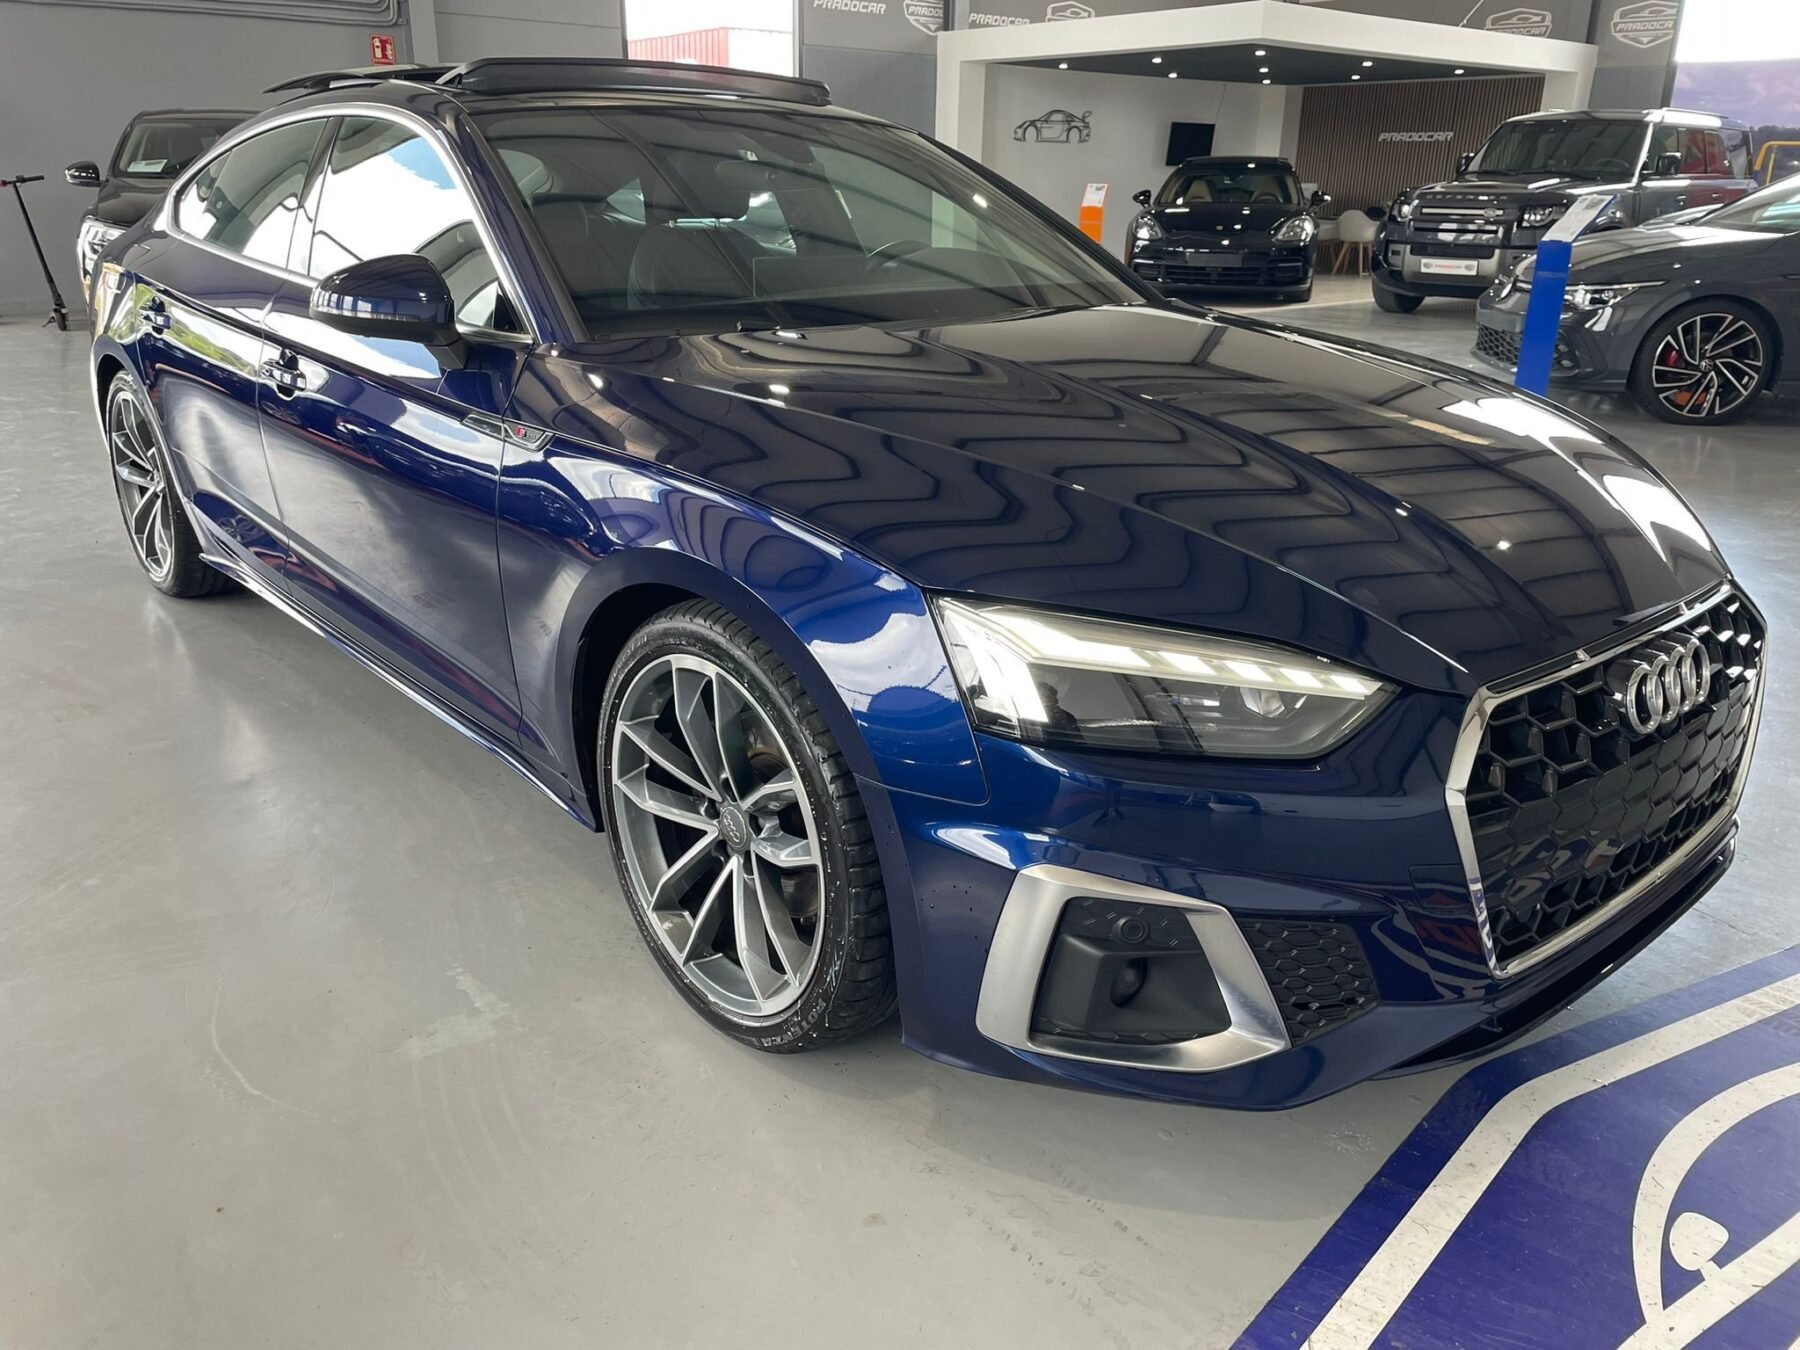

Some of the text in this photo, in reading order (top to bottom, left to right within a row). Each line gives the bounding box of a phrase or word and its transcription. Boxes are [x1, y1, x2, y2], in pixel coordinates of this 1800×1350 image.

[813, 0, 886, 15] PRADOCAR
[1615, 20, 1675, 32] PRADOCA
[1378, 131, 1454, 142] PRADOCAR
